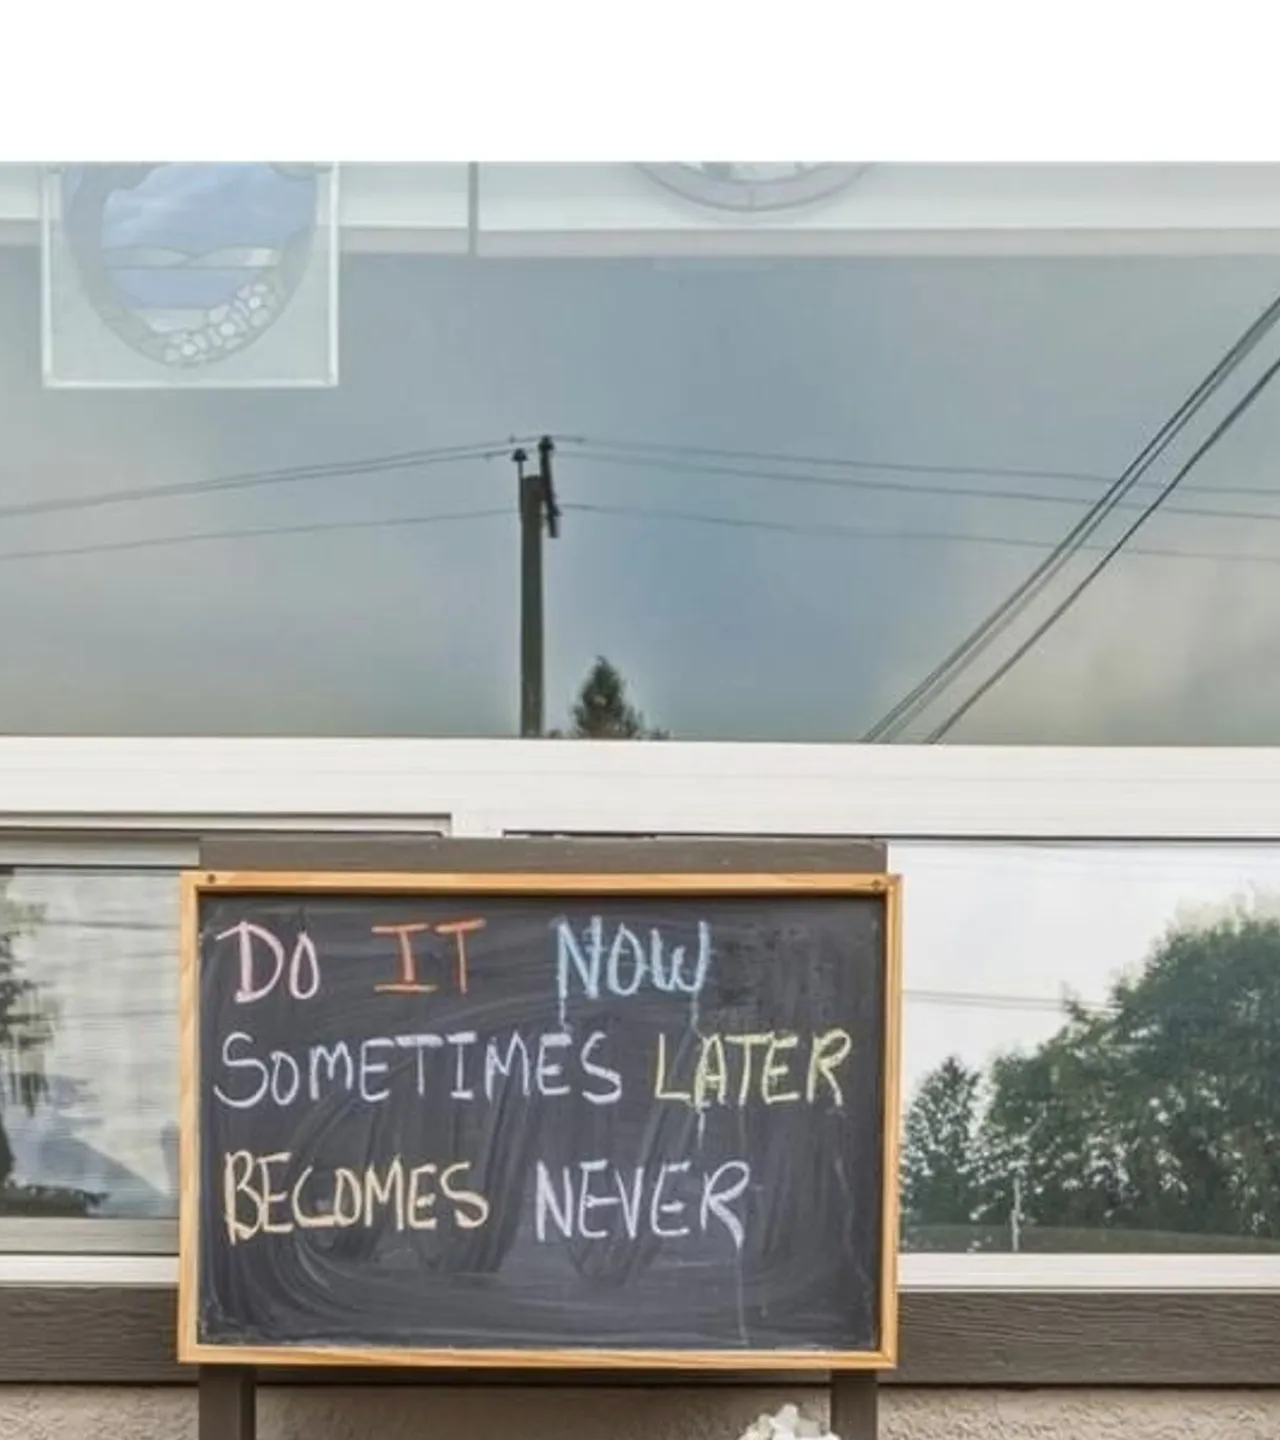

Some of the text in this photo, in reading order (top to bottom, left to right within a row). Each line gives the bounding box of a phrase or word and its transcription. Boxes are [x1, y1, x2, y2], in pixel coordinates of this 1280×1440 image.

[216, 914, 713, 1002] DO IT NOW
[213, 1029, 853, 1110] SOMETIMES LATER
[223, 1150, 751, 1249] BECOMES NEVER
